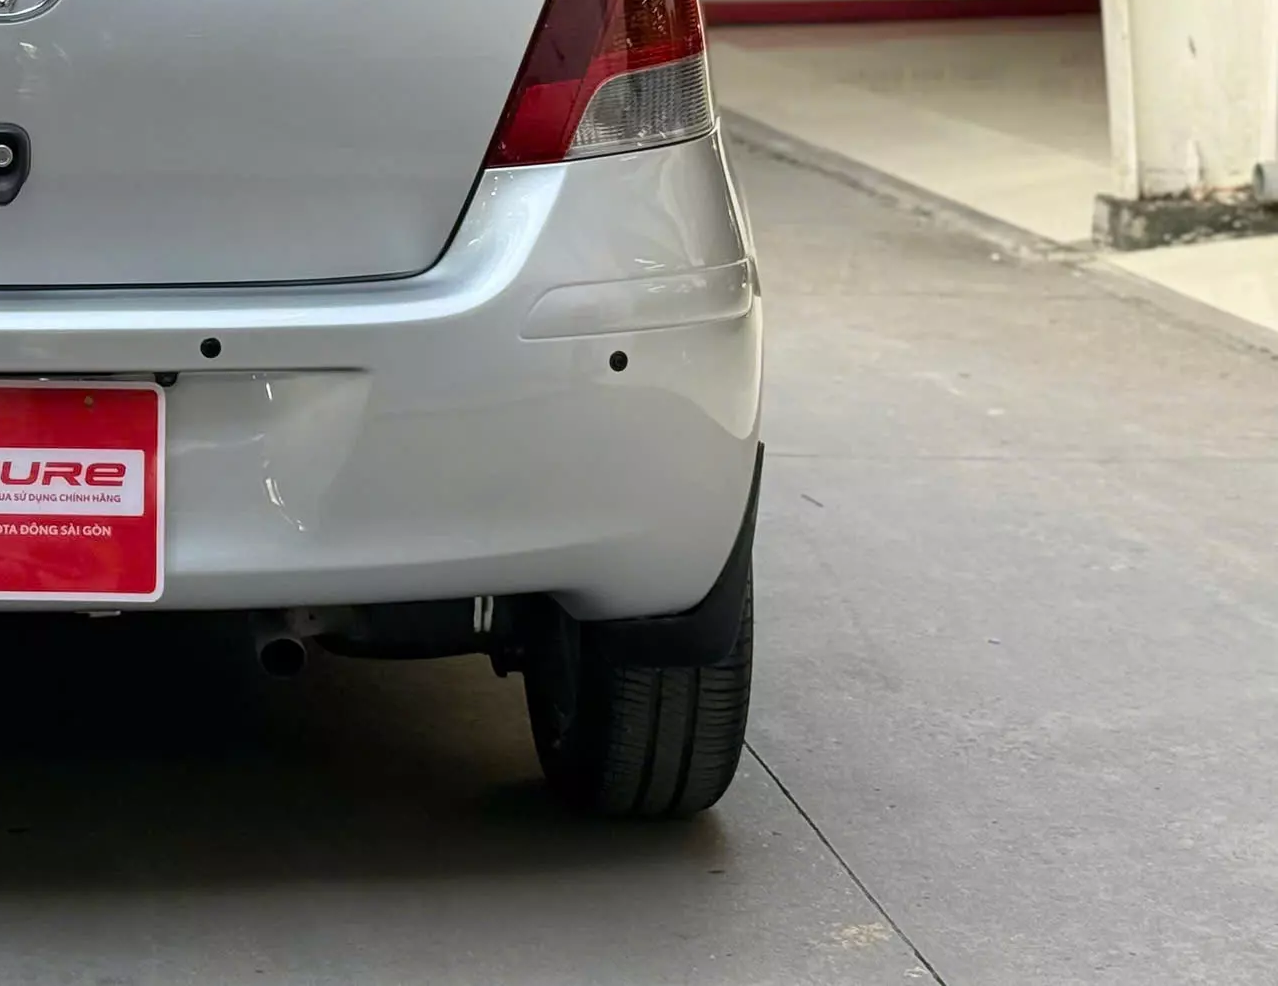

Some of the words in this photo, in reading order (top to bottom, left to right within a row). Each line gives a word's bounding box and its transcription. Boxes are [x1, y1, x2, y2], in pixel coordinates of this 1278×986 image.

[28, 492, 57, 504] DỤNG
[59, 491, 91, 503] CHÍNH
[20, 522, 59, 536] ĐÔNG
[60, 522, 80, 536] SÀI
[82, 522, 112, 537] GÒN
